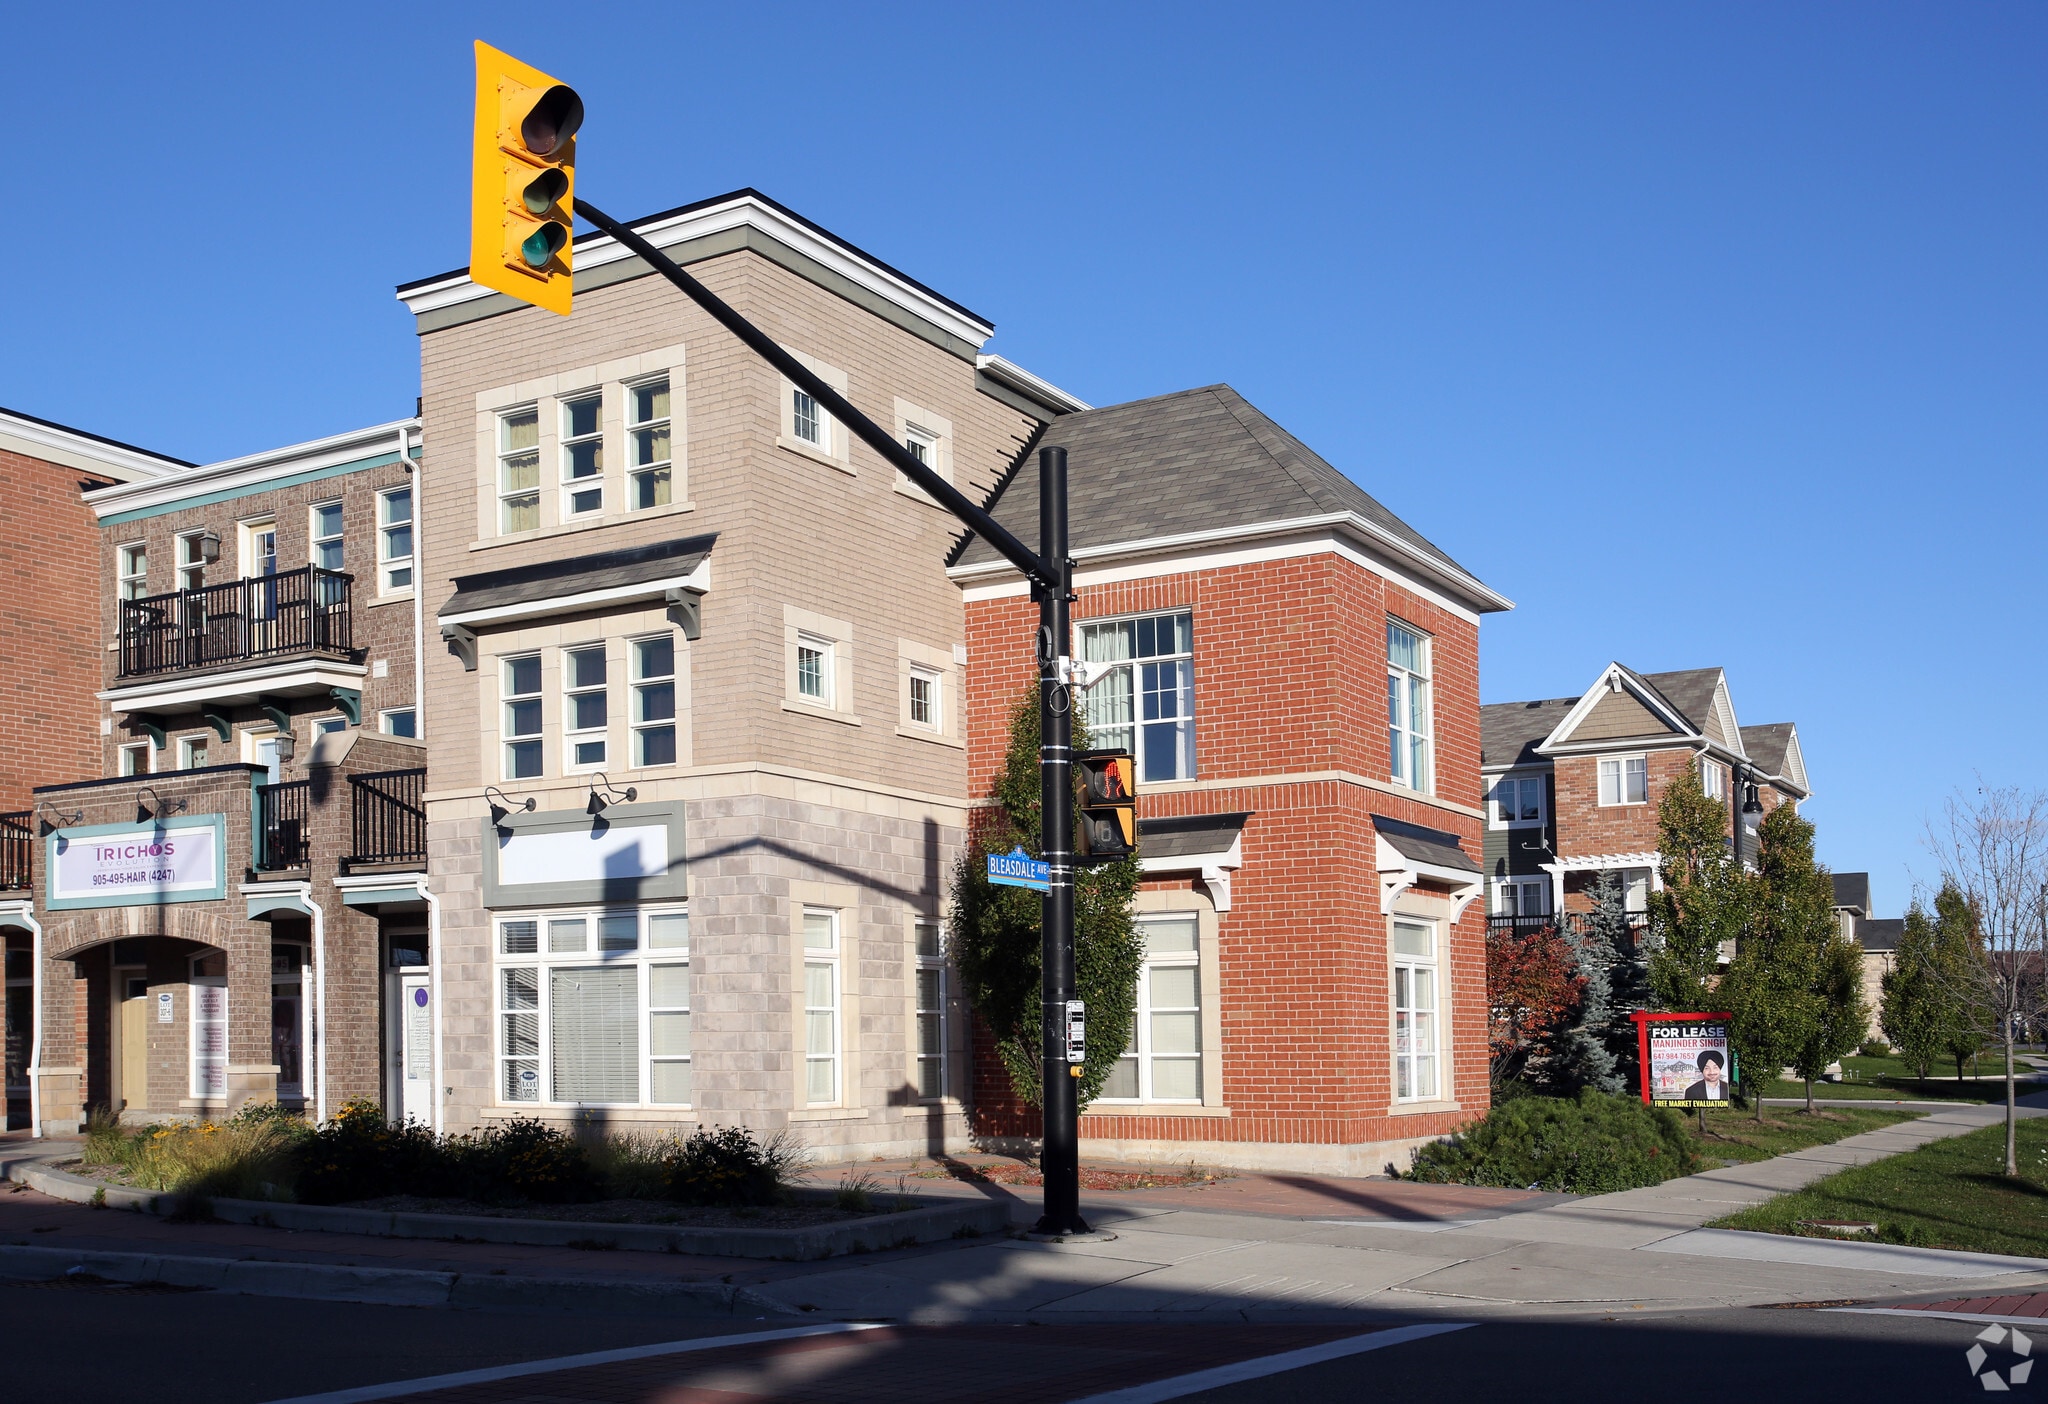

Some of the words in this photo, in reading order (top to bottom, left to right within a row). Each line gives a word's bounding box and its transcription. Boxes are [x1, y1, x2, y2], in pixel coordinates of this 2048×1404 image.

[100, 857, 169, 868] EVOLUTION
[990, 857, 1036, 878] BLEASDALE
[1037, 864, 1047, 875] AVE
[92, 871, 147, 885] 905-495-HAIR
[149, 869, 175, 884] (4247)
[1652, 1027, 1680, 1038] FOR
[1682, 1027, 1725, 1038] LEASE
[1653, 1039, 1698, 1048] MANJINDER
[1700, 1038, 1726, 1048] SINGH
[1654, 1100, 1668, 1108] FREE
[1668, 1100, 1692, 1108] MARKET
[1692, 1100, 1729, 1108] EVALUATION
